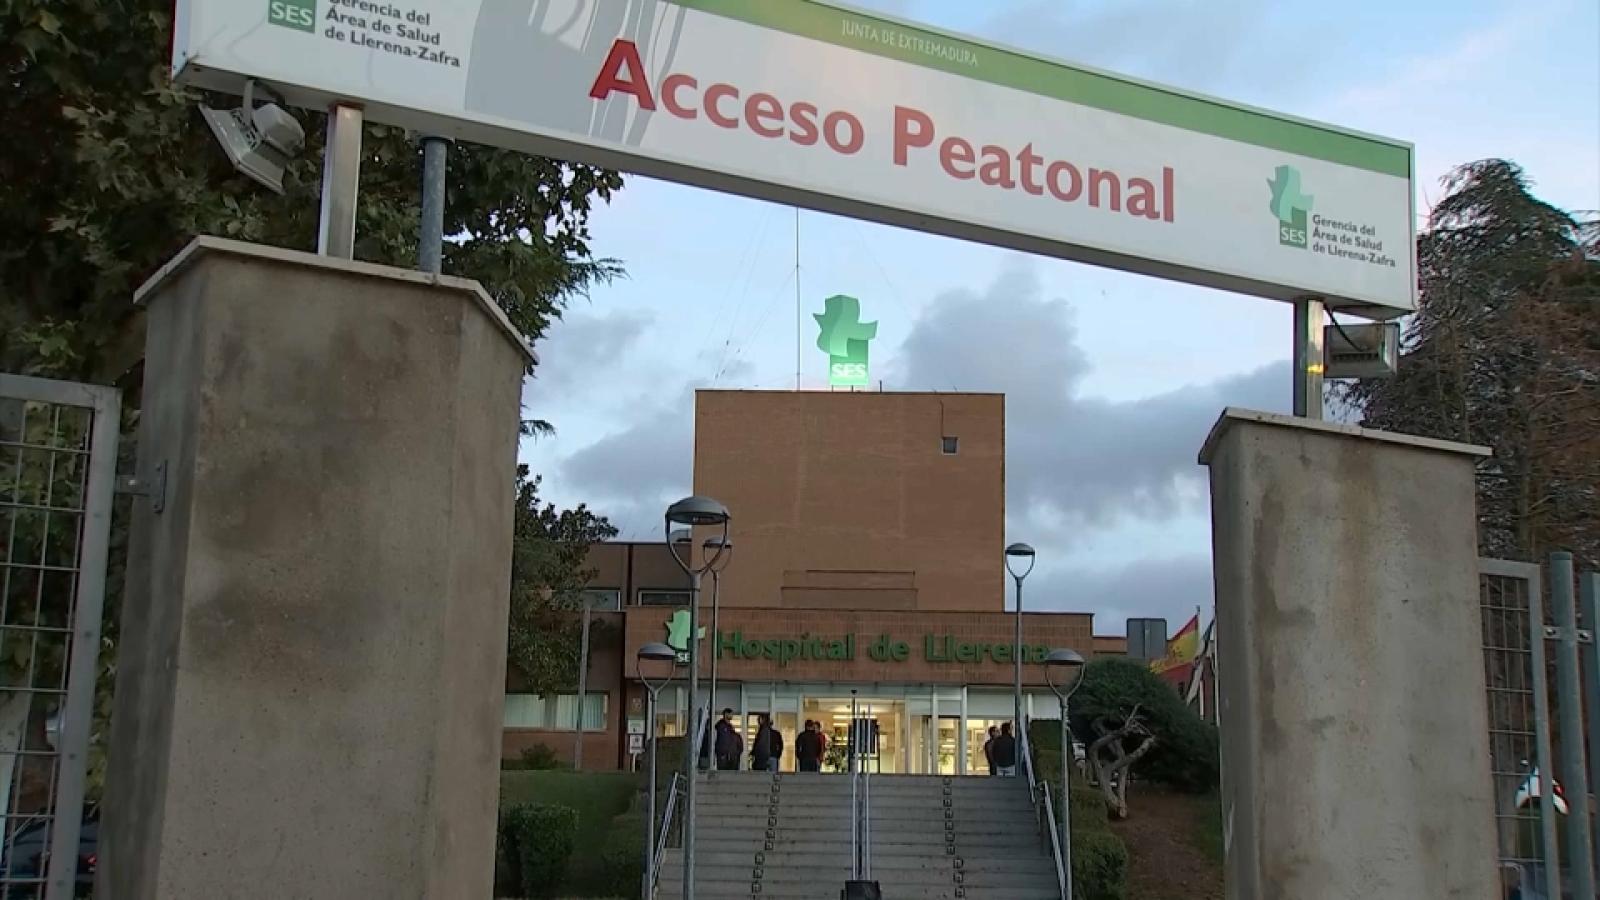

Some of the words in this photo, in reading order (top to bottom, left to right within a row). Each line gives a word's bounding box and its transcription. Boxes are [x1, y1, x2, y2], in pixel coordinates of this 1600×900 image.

[271, 1, 313, 26] SES
[326, 6, 366, 28] Área
[371, 19, 392, 34] de
[396, 24, 440, 45] Salud
[329, 0, 401, 19] erencia
[406, 9, 430, 26] del
[324, 26, 345, 41] de
[351, 31, 461, 67] Llerena-Zafra
[841, 19, 878, 41] JUNTA
[882, 29, 895, 45] DE
[899, 33, 978, 66] EXTREMADURA
[589, 38, 864, 155] Acceso
[893, 105, 1174, 223] Peatonal
[1280, 227, 1306, 244] SES
[1312, 214, 1357, 232] Gerencia
[1359, 225, 1376, 236] del
[1312, 226, 1338, 242] Área
[1339, 233, 1353, 245] de
[1354, 236, 1382, 251] Salud
[1312, 242, 1326, 253] de
[1327, 245, 1396, 267] Llerena-Zafra
[831, 363, 866, 376] SES
[718, 631, 854, 666] Hospital
[868, 633, 910, 662] de
[925, 633, 1049, 664] Llerena
